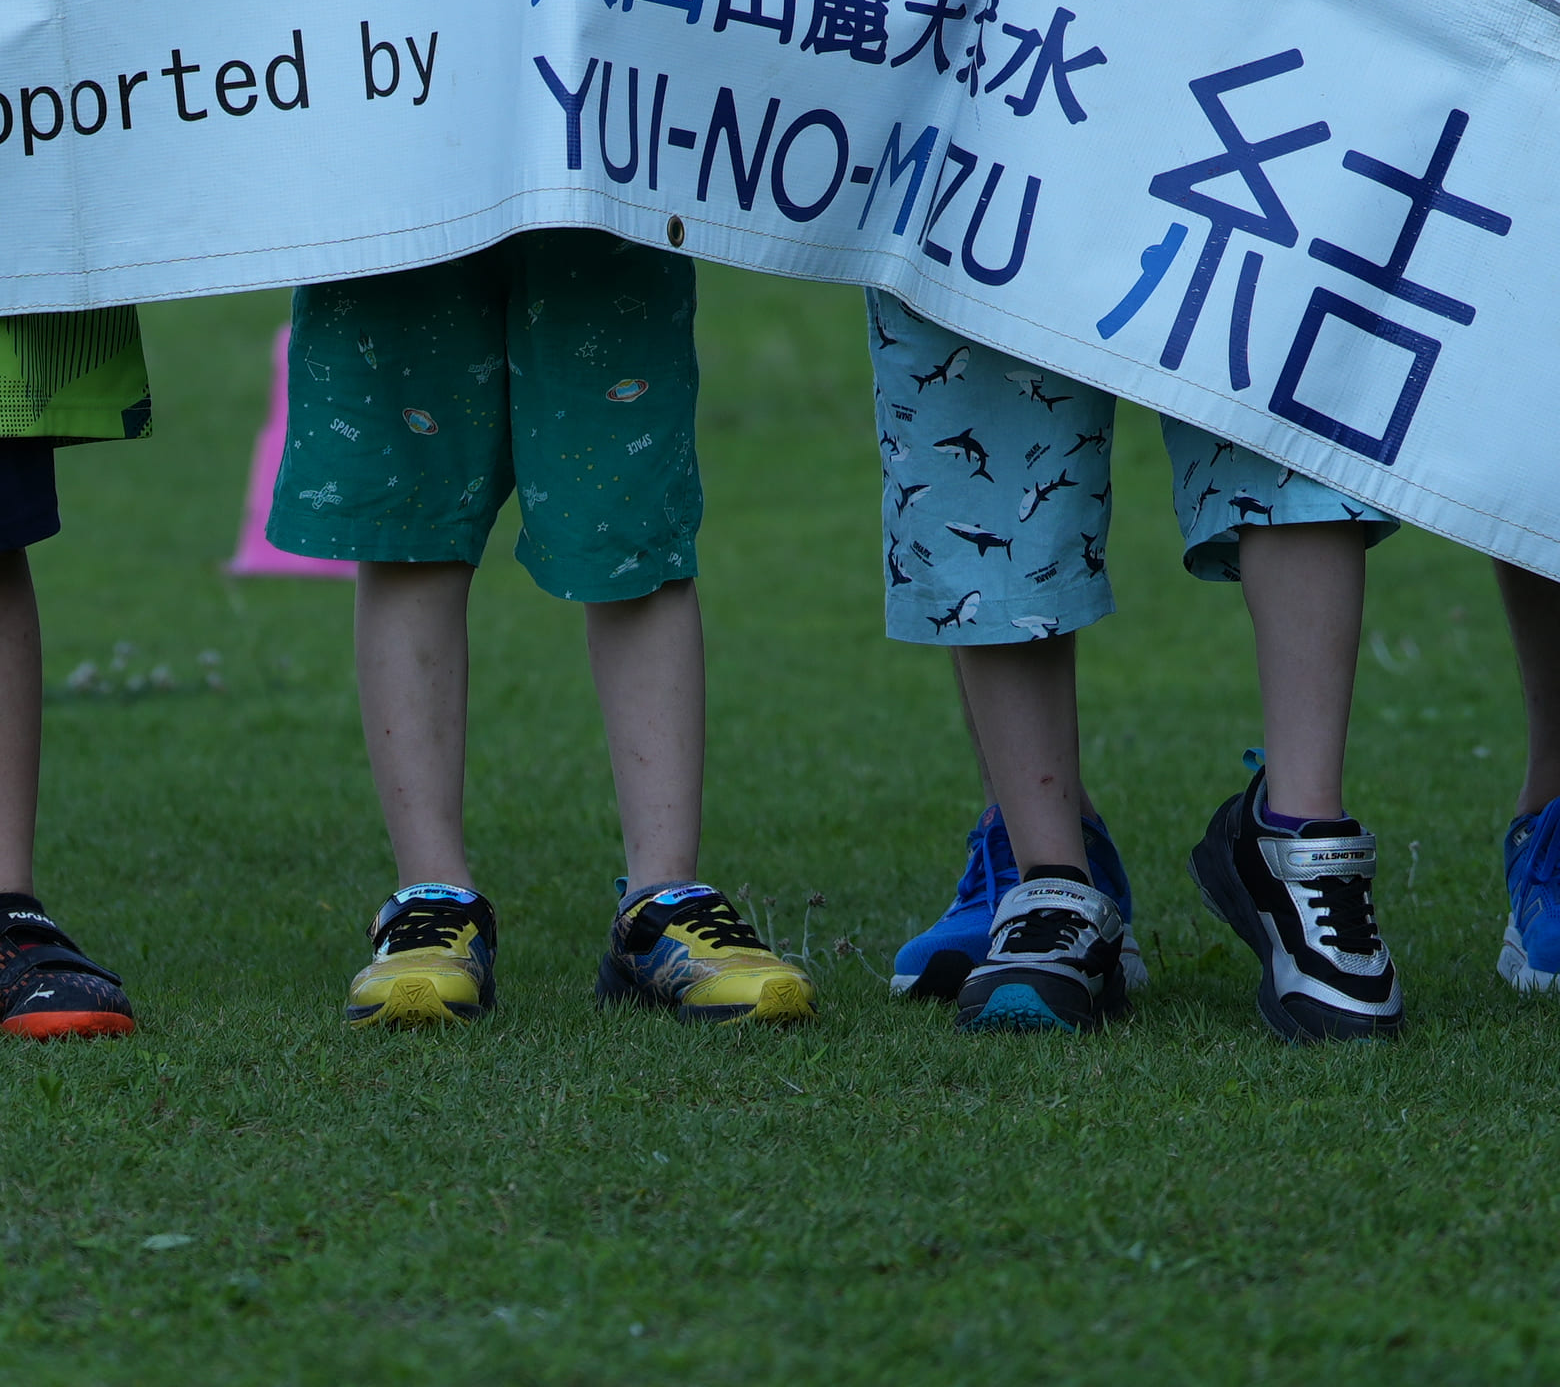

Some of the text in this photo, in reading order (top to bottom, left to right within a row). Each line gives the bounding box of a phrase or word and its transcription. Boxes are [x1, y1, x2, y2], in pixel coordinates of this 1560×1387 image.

[360, 21, 438, 106] by
[1095, 48, 1513, 467] 結
[330, 418, 361, 442] SPACE
[625, 433, 653, 456] SPACE
